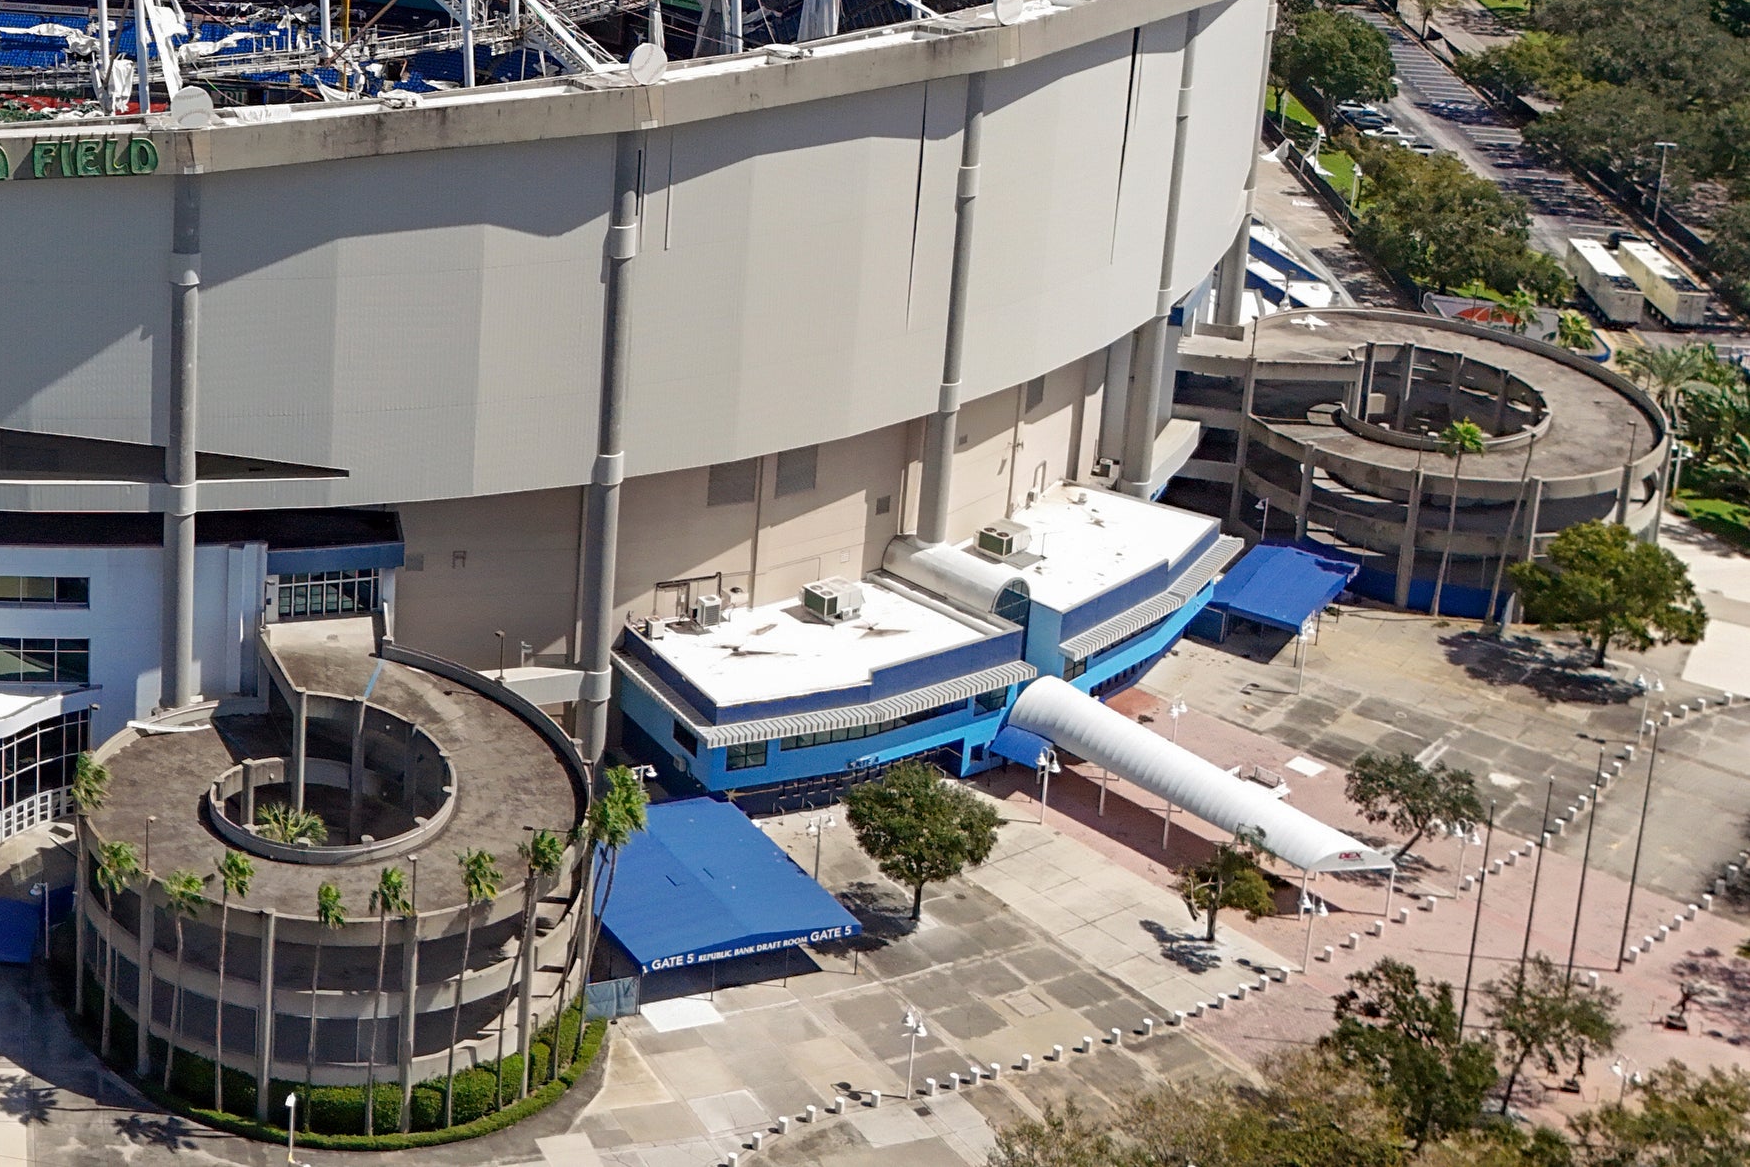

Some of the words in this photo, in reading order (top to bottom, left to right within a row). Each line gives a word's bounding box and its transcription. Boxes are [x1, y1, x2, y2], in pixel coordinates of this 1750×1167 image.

[33, 137, 159, 179] FIELD
[652, 954, 683, 970] GATE
[687, 953, 694, 964] 5
[698, 949, 732, 962] REPUBLIC
[734, 946, 756, 956] BANK
[756, 940, 782, 952] DRAFT
[783, 936, 808, 947] ROOM
[810, 927, 842, 942] GATE
[844, 925, 852, 935] 5
